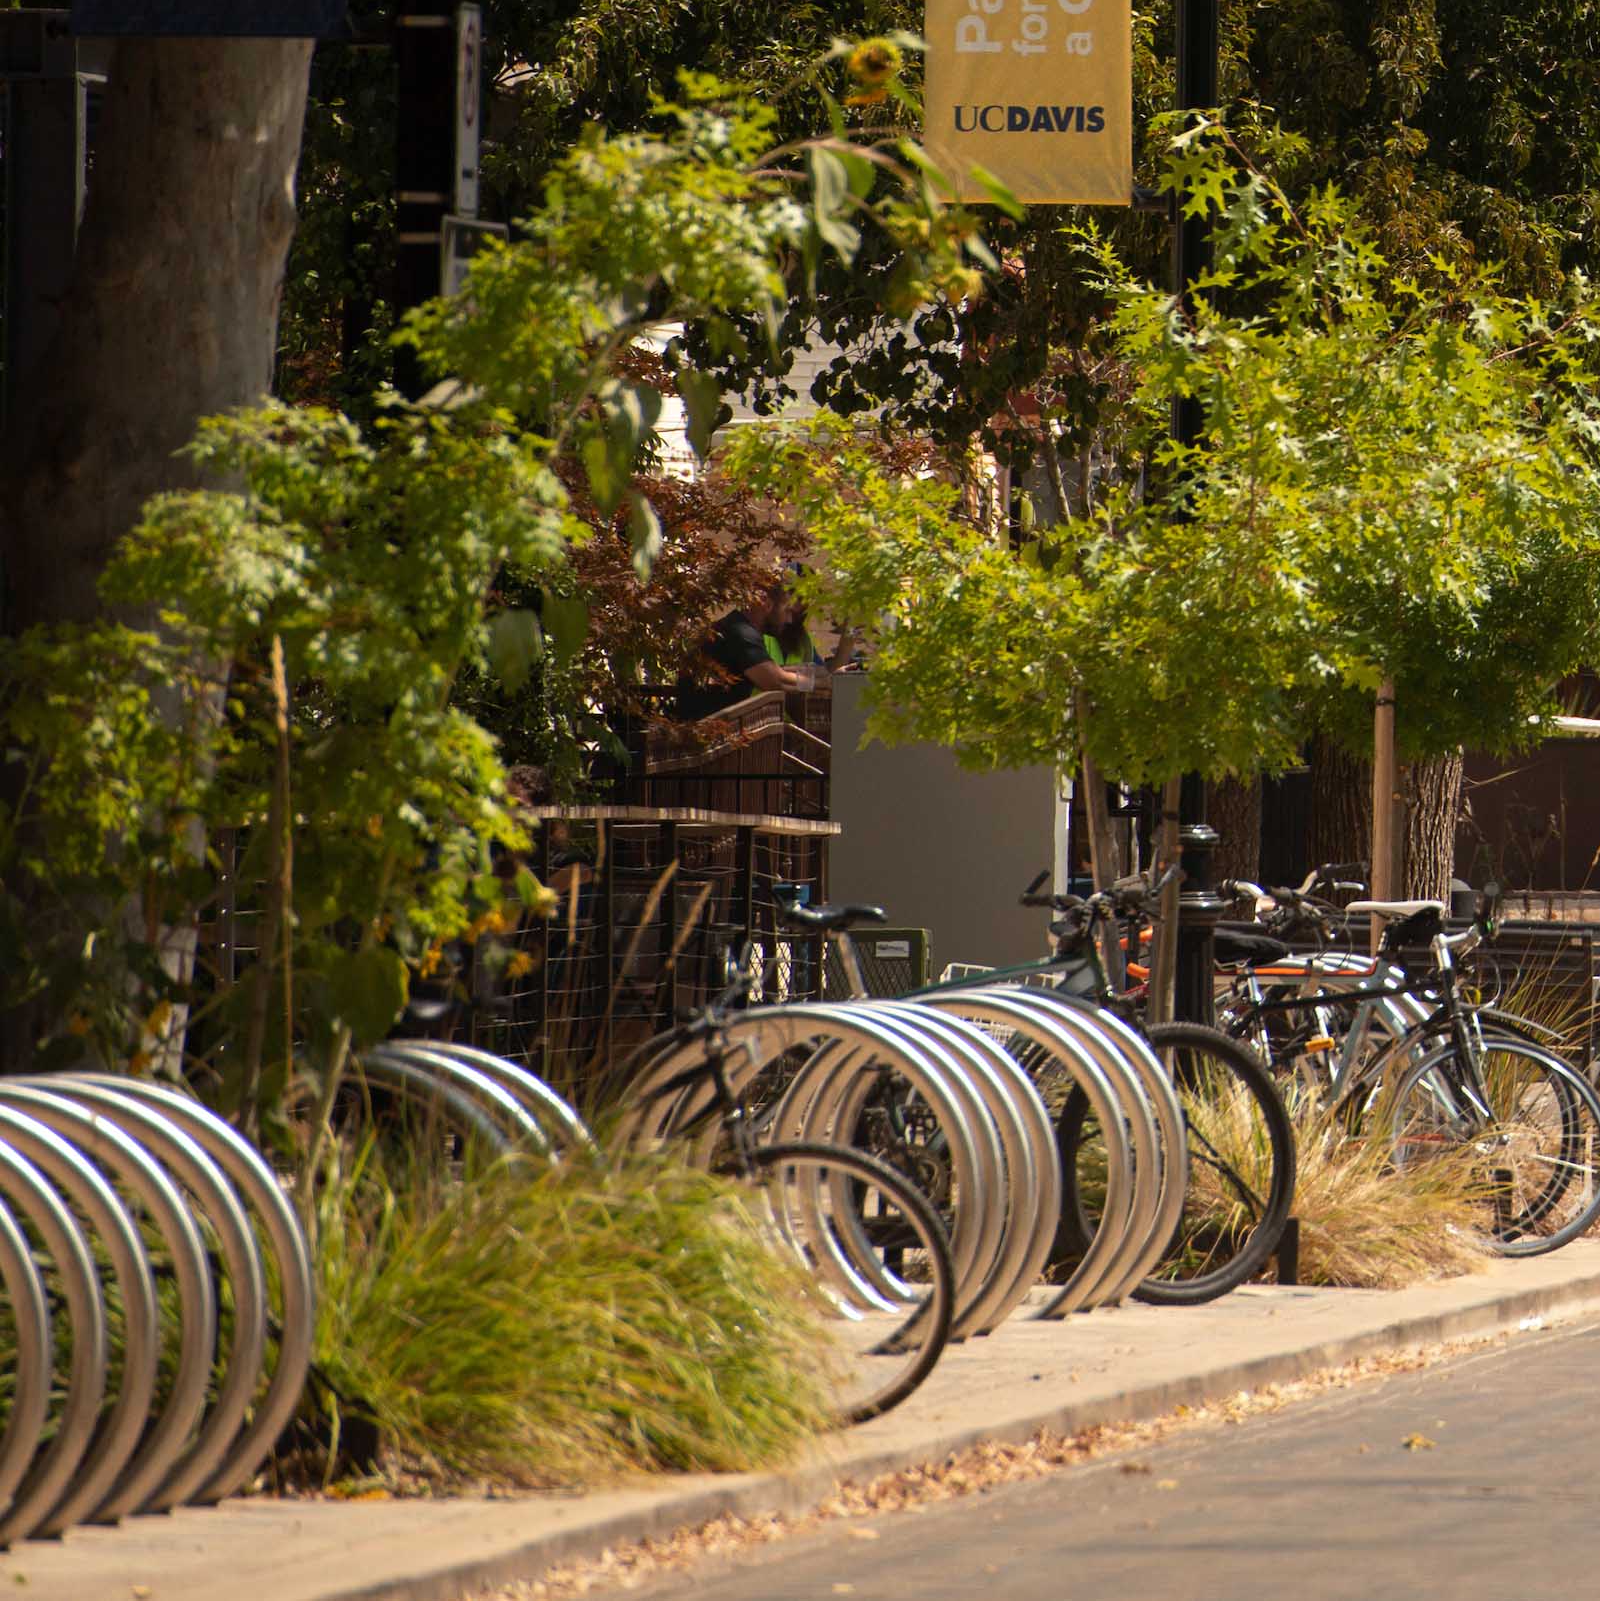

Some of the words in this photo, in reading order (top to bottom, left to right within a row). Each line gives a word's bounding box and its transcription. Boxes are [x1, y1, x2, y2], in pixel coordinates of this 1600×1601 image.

[1013, 0, 1048, 56] for
[1065, 30, 1094, 55] a
[953, 105, 1105, 133] UCDAVIS
